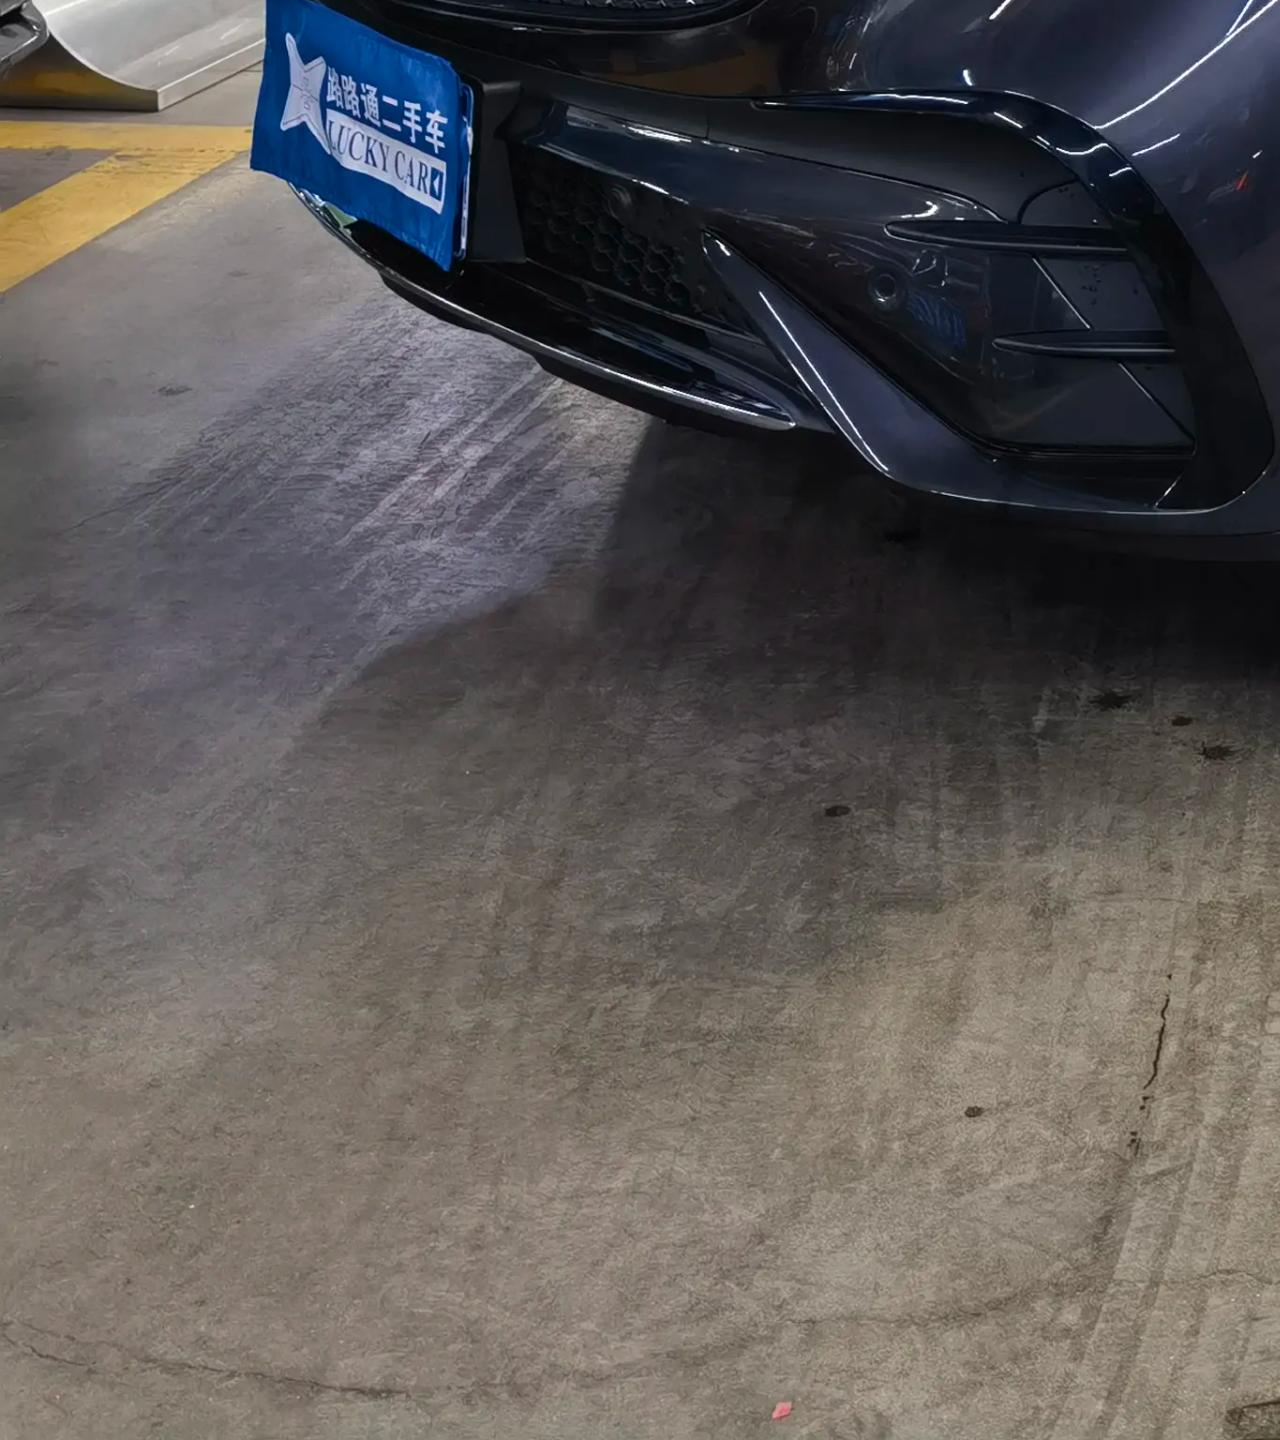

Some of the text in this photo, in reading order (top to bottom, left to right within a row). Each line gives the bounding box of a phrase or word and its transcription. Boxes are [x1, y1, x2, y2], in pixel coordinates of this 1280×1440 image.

[326, 65, 449, 155] 路路通二手车
[327, 120, 429, 194] LUCKY CAR
